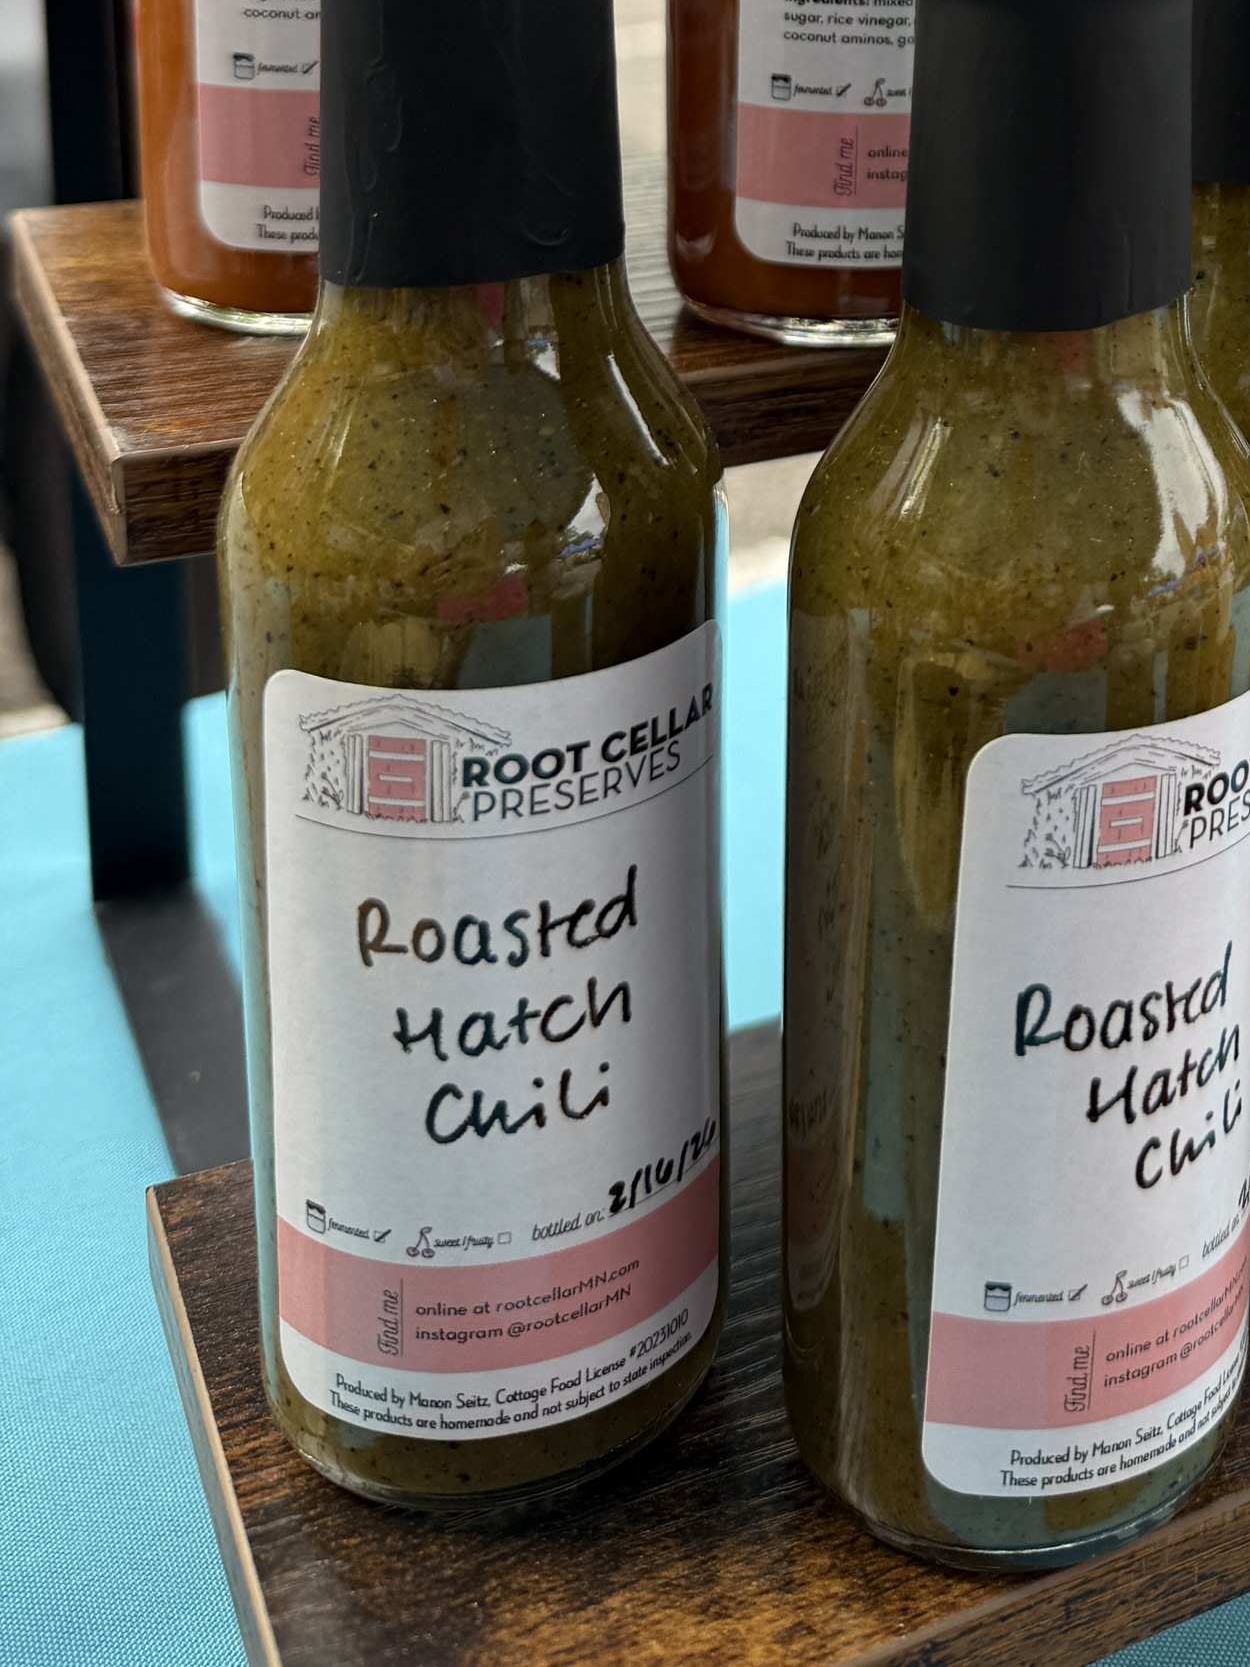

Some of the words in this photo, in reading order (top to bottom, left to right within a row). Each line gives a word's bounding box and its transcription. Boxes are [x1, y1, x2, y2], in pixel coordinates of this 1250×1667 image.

[243, 8, 301, 20] coconut
[784, 11, 824, 25] sugar,
[827, 13, 853, 25] rice
[858, 15, 912, 27] vinegar,
[783, 31, 837, 44] coconut
[841, 32, 893, 46] aminos,
[867, 147, 908, 159] online
[867, 169, 907, 182] instag
[257, 224, 286, 241] These
[264, 205, 314, 222] Produced
[793, 222, 841, 240] Produced
[843, 225, 855, 243] by
[859, 226, 894, 241] Manon
[786, 241, 814, 258] These
[818, 245, 860, 262] products
[864, 248, 880, 260] are
[463, 739, 591, 788] ROOT
[601, 682, 714, 764] CELLAR
[473, 740, 682, 823] PRESERVES
[358, 864, 639, 967] Roasted
[1016, 940, 1232, 1056] Roasted
[393, 976, 632, 1061] Hatch
[1086, 1024, 1240, 1124] Hatch
[425, 1062, 610, 1144] Chili
[1136, 1079, 1242, 1189] Chili
[532, 1212, 582, 1241] bottled
[383, 1290, 400, 1316] me
[416, 1304, 467, 1317] online
[473, 1301, 490, 1315] at
[496, 1259, 641, 1312] rootcellarMN.com
[1014, 1291, 1063, 1307] fermented
[416, 1327, 503, 1344] instagram
[508, 1284, 631, 1338] @rootcellarMN
[378, 1316, 400, 1356] Find
[1106, 1342, 1151, 1363] online
[1156, 1330, 1169, 1346] at
[336, 1373, 387, 1402] Produced
[391, 1390, 405, 1408] by
[409, 1392, 451, 1409] Manon
[456, 1393, 491, 1410] Seitz,
[496, 1386, 547, 1406] Cottage
[551, 1370, 581, 1394] Food
[586, 1355, 626, 1383] License
[629, 1308, 689, 1359] #20231010
[1073, 1345, 1091, 1370] me
[1103, 1351, 1178, 1388] instagram
[329, 1389, 360, 1415] These
[364, 1408, 413, 1428] products
[416, 1418, 436, 1429] are
[440, 1410, 511, 1430] homemade
[514, 1404, 539, 1423] and
[542, 1404, 562, 1417] not
[565, 1388, 605, 1411] subject
[609, 1380, 620, 1393] to
[624, 1366, 648, 1386] state
[1064, 1374, 1089, 1413] Find
[1010, 1446, 1070, 1466] Produced
[1074, 1444, 1089, 1463] by
[1092, 1437, 1132, 1458] Manon
[1135, 1423, 1164, 1445] Seitz,
[1167, 1400, 1202, 1430] Cottage
[1203, 1375, 1222, 1407] Food
[1001, 1469, 1037, 1487] These
[1041, 1466, 1094, 1489] products
[1097, 1461, 1116, 1475] are
[1119, 1434, 1177, 1471] homemade
[1178, 1417, 1197, 1444] and
[1198, 1409, 1210, 1430] not
